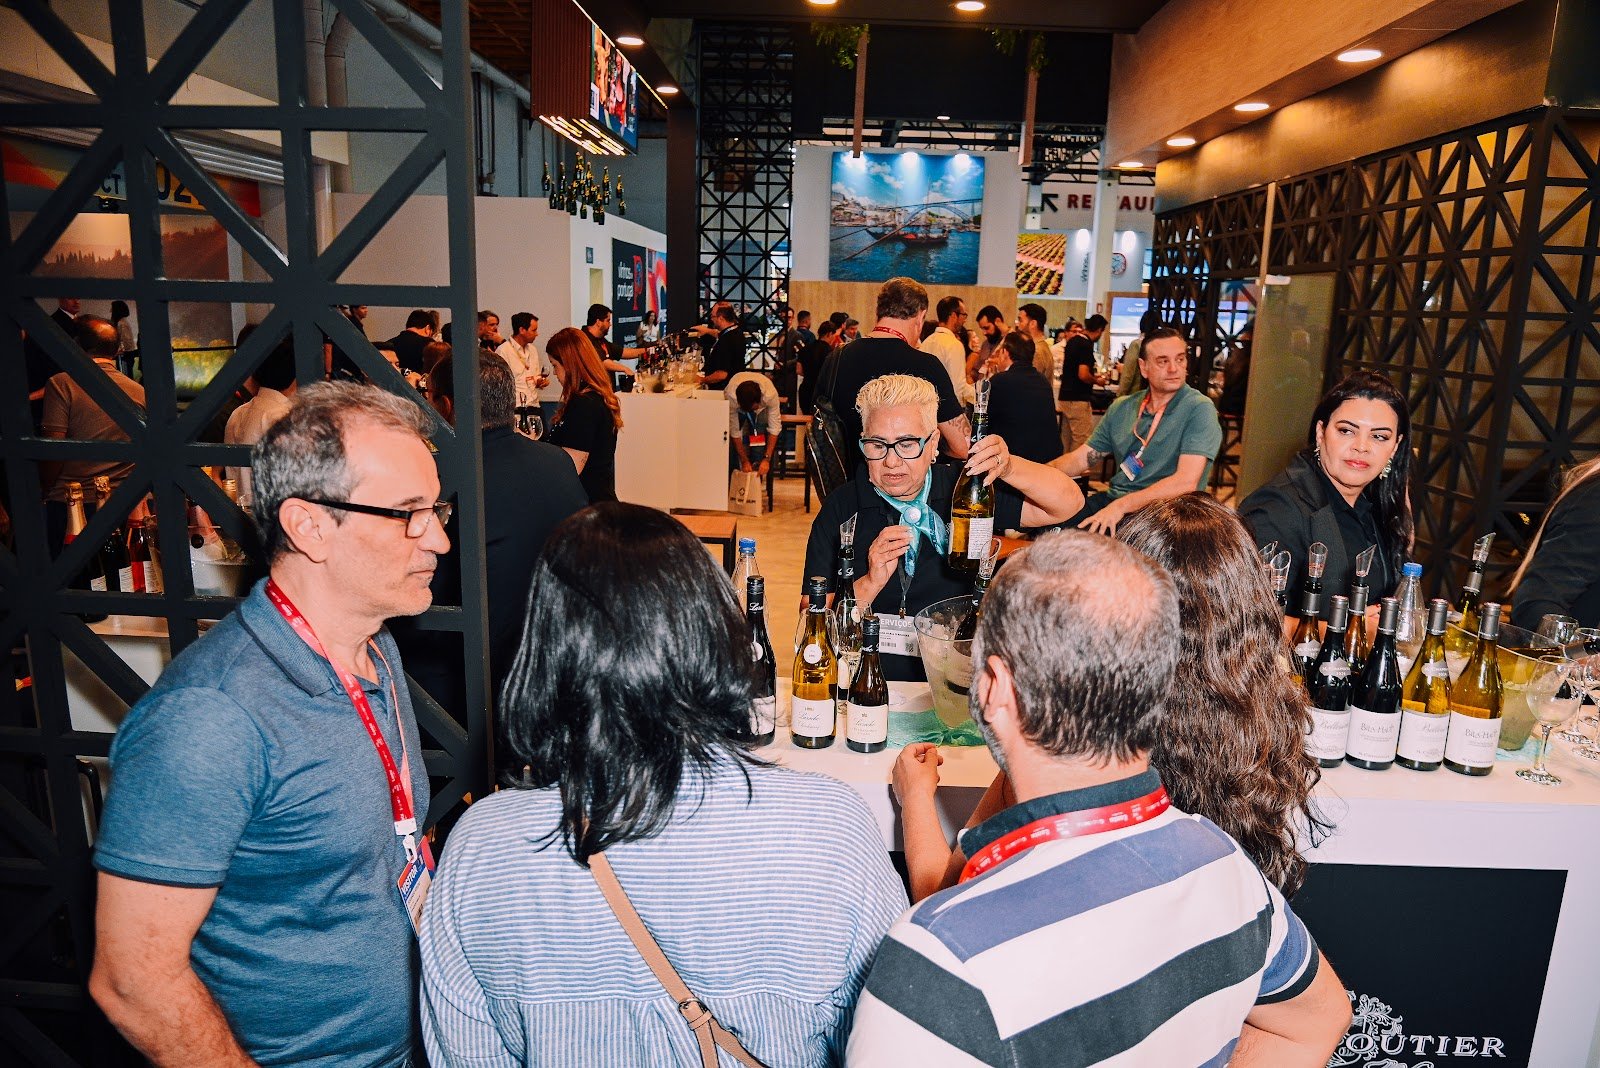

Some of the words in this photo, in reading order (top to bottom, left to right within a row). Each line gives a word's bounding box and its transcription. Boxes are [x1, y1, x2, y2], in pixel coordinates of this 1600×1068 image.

[880, 619, 912, 628] ERVIÇOS
[402, 864, 418, 894] VISITOR
[1345, 1033, 1507, 1058] OUTIER
